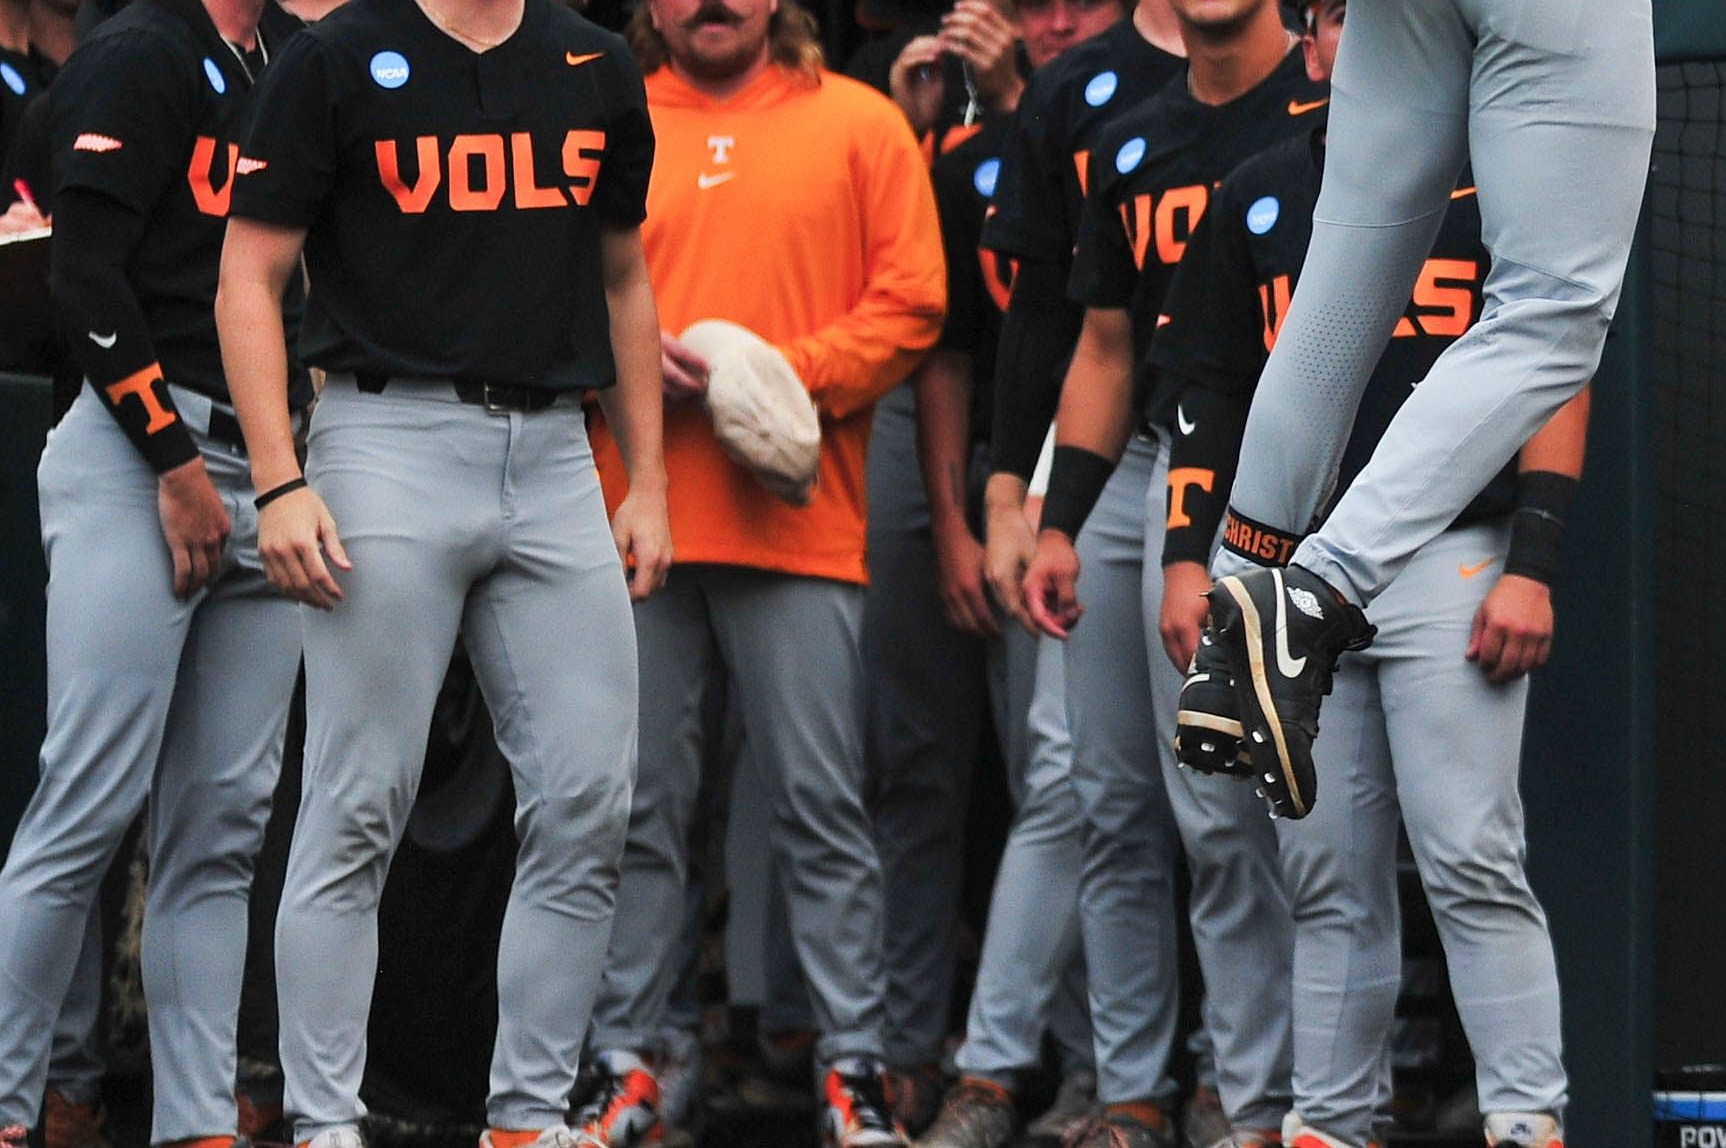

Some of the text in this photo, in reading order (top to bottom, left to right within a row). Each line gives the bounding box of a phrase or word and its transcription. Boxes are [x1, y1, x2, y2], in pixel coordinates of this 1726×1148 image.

[377, 68, 408, 80] NCAA
[375, 129, 606, 213] VOLS
[707, 135, 735, 164] T
[105, 360, 177, 436] T
